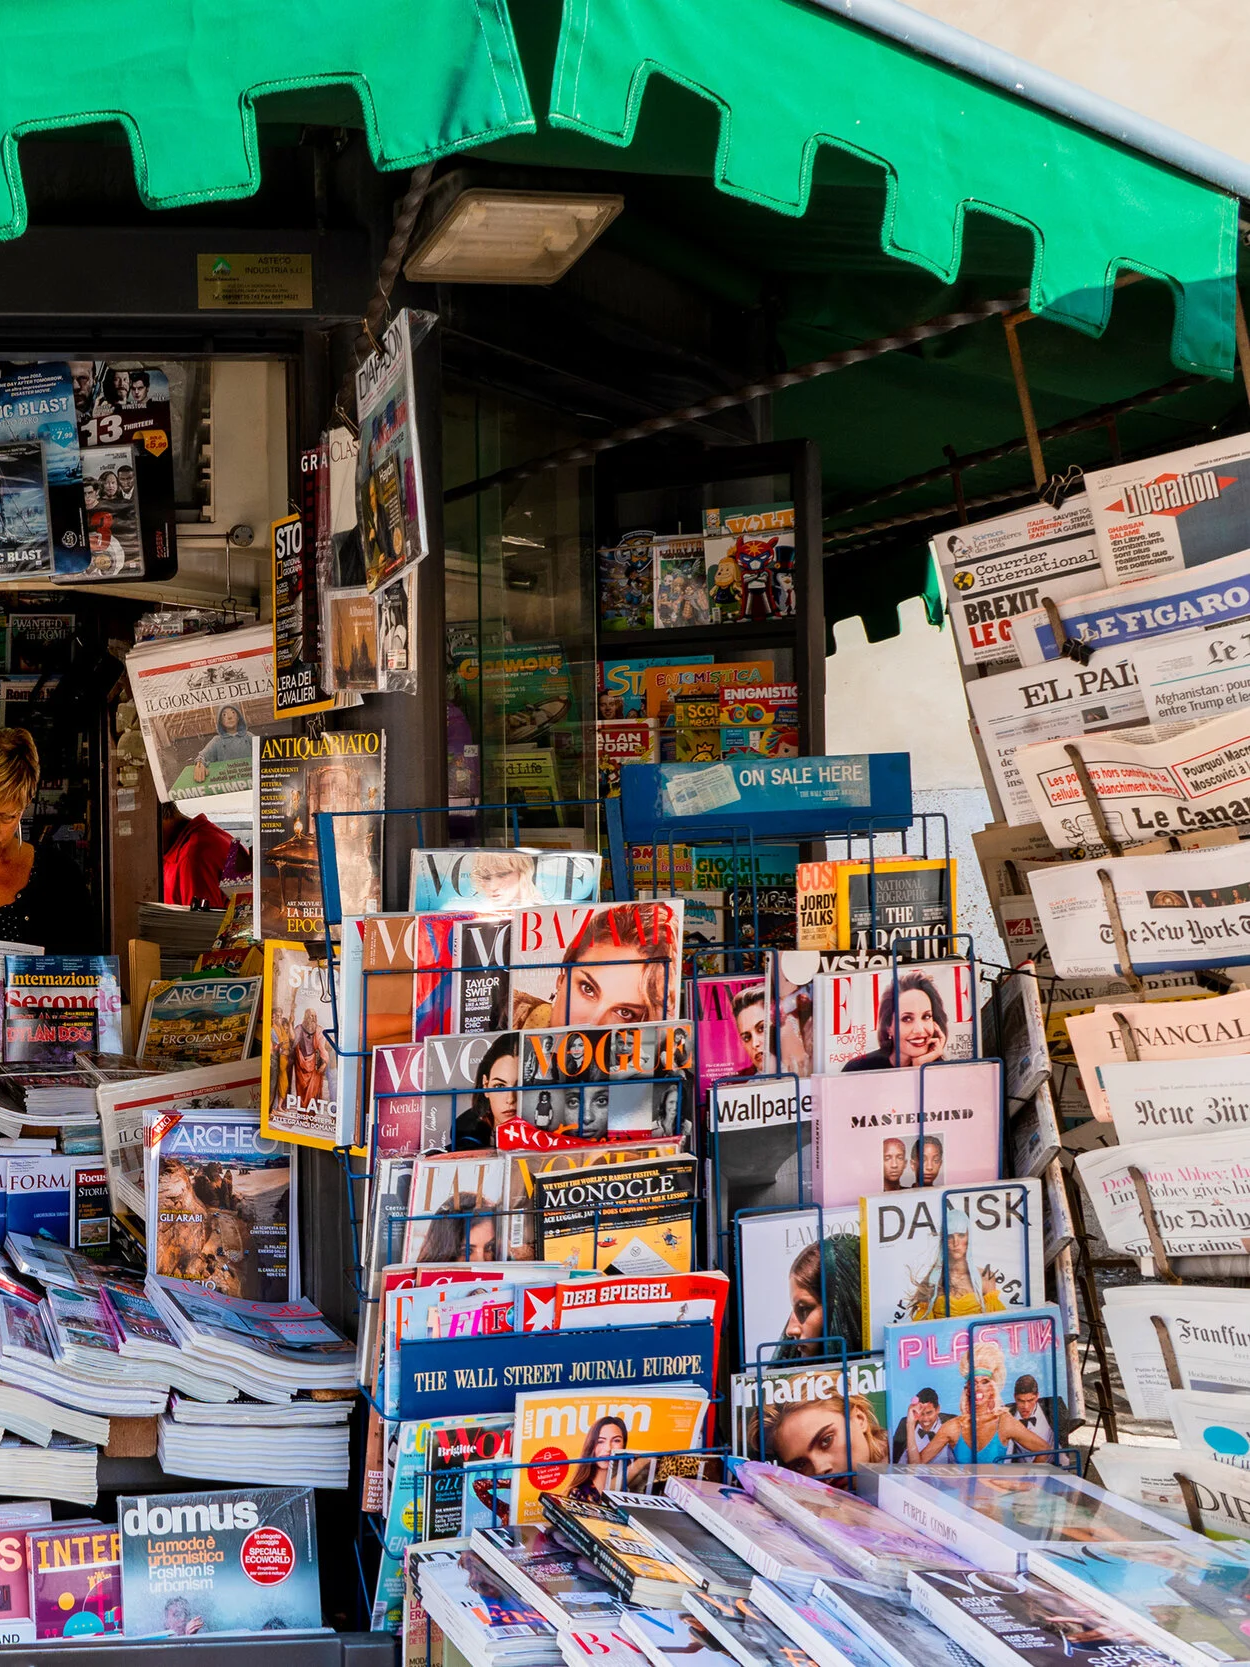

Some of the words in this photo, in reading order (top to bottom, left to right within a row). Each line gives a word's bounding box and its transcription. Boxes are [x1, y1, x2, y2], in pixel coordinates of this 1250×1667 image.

[18, 397, 69, 416] BLAST
[82, 415, 123, 446] 13
[123, 419, 154, 430] THIRTEEN
[1121, 470, 1221, 515] Libération
[7, 550, 42, 564] BLAST
[976, 551, 1047, 576] Courrier
[979, 550, 1098, 587] international
[963, 588, 1039, 626] BREXIT
[1116, 585, 1250, 634] FIGARO
[277, 675, 296, 690] L'ERA
[299, 671, 312, 686] DEI
[656, 670, 763, 686] ENIGMISTICA
[158, 687, 224, 711] GIORNALE
[277, 687, 316, 706] CAVALIERI
[1018, 679, 1073, 709] EL
[1155, 684, 1219, 706] Afghanistan
[1159, 704, 1188, 718] entre
[1190, 696, 1224, 712] Trump
[261, 732, 379, 761] ANTIQUARIATO
[597, 743, 640, 753] FORD
[1183, 754, 1225, 778] Pourquoi
[739, 770, 765, 787] ON
[771, 767, 813, 785] SALE
[818, 765, 863, 783] HERE
[1190, 770, 1237, 792] Moscovici
[800, 893, 837, 911] JORDY
[800, 910, 833, 927] TALKS
[885, 906, 914, 924] THE
[520, 905, 674, 953] BAZAAR
[1141, 920, 1184, 942] New
[1191, 917, 1236, 944] York
[465, 977, 500, 990] TAYLOR
[465, 987, 493, 999] SWIFT
[163, 984, 247, 1006] ARCHEO
[7, 1026, 56, 1042] DYLAN
[58, 1027, 92, 1042] DOG
[162, 1032, 233, 1044] ERCOLANO
[837, 1034, 866, 1045] POWER
[1107, 1018, 1250, 1049] FNANCIAL
[526, 1025, 693, 1078] VOGUE
[829, 1052, 866, 1063] FASHION
[850, 1108, 975, 1129] MASTERMIND
[169, 1124, 278, 1154] ARCHEO
[78, 1172, 107, 1184] Focus
[632, 1169, 660, 1179] FESTIVAL
[1178, 1166, 1228, 1181] Abbey:
[78, 1186, 108, 1197] STORIA
[544, 1175, 675, 1208] MONOCLE
[160, 1214, 174, 1222] GLI
[176, 1214, 203, 1222] ARABI
[1198, 1239, 1242, 1251] aims
[562, 1290, 597, 1307] DER
[599, 1283, 672, 1303] SPIEGEL
[414, 1370, 448, 1394] THE
[454, 1367, 499, 1389] WALL
[503, 1365, 564, 1386] STREET
[568, 1360, 636, 1382] JOURNAL
[642, 1355, 704, 1378] EUROPE.
[534, 1403, 652, 1440] mum
[437, 1444, 477, 1458] Brigitte
[123, 1498, 259, 1537] domus
[164, 1536, 206, 1552] moda
[249, 1548, 286, 1556] SPECIALE
[148, 1551, 224, 1566] urbanistica
[245, 1556, 290, 1564] ECOWORLD
[149, 1565, 201, 1580] Fashion
[150, 1577, 214, 1592] urbanism
